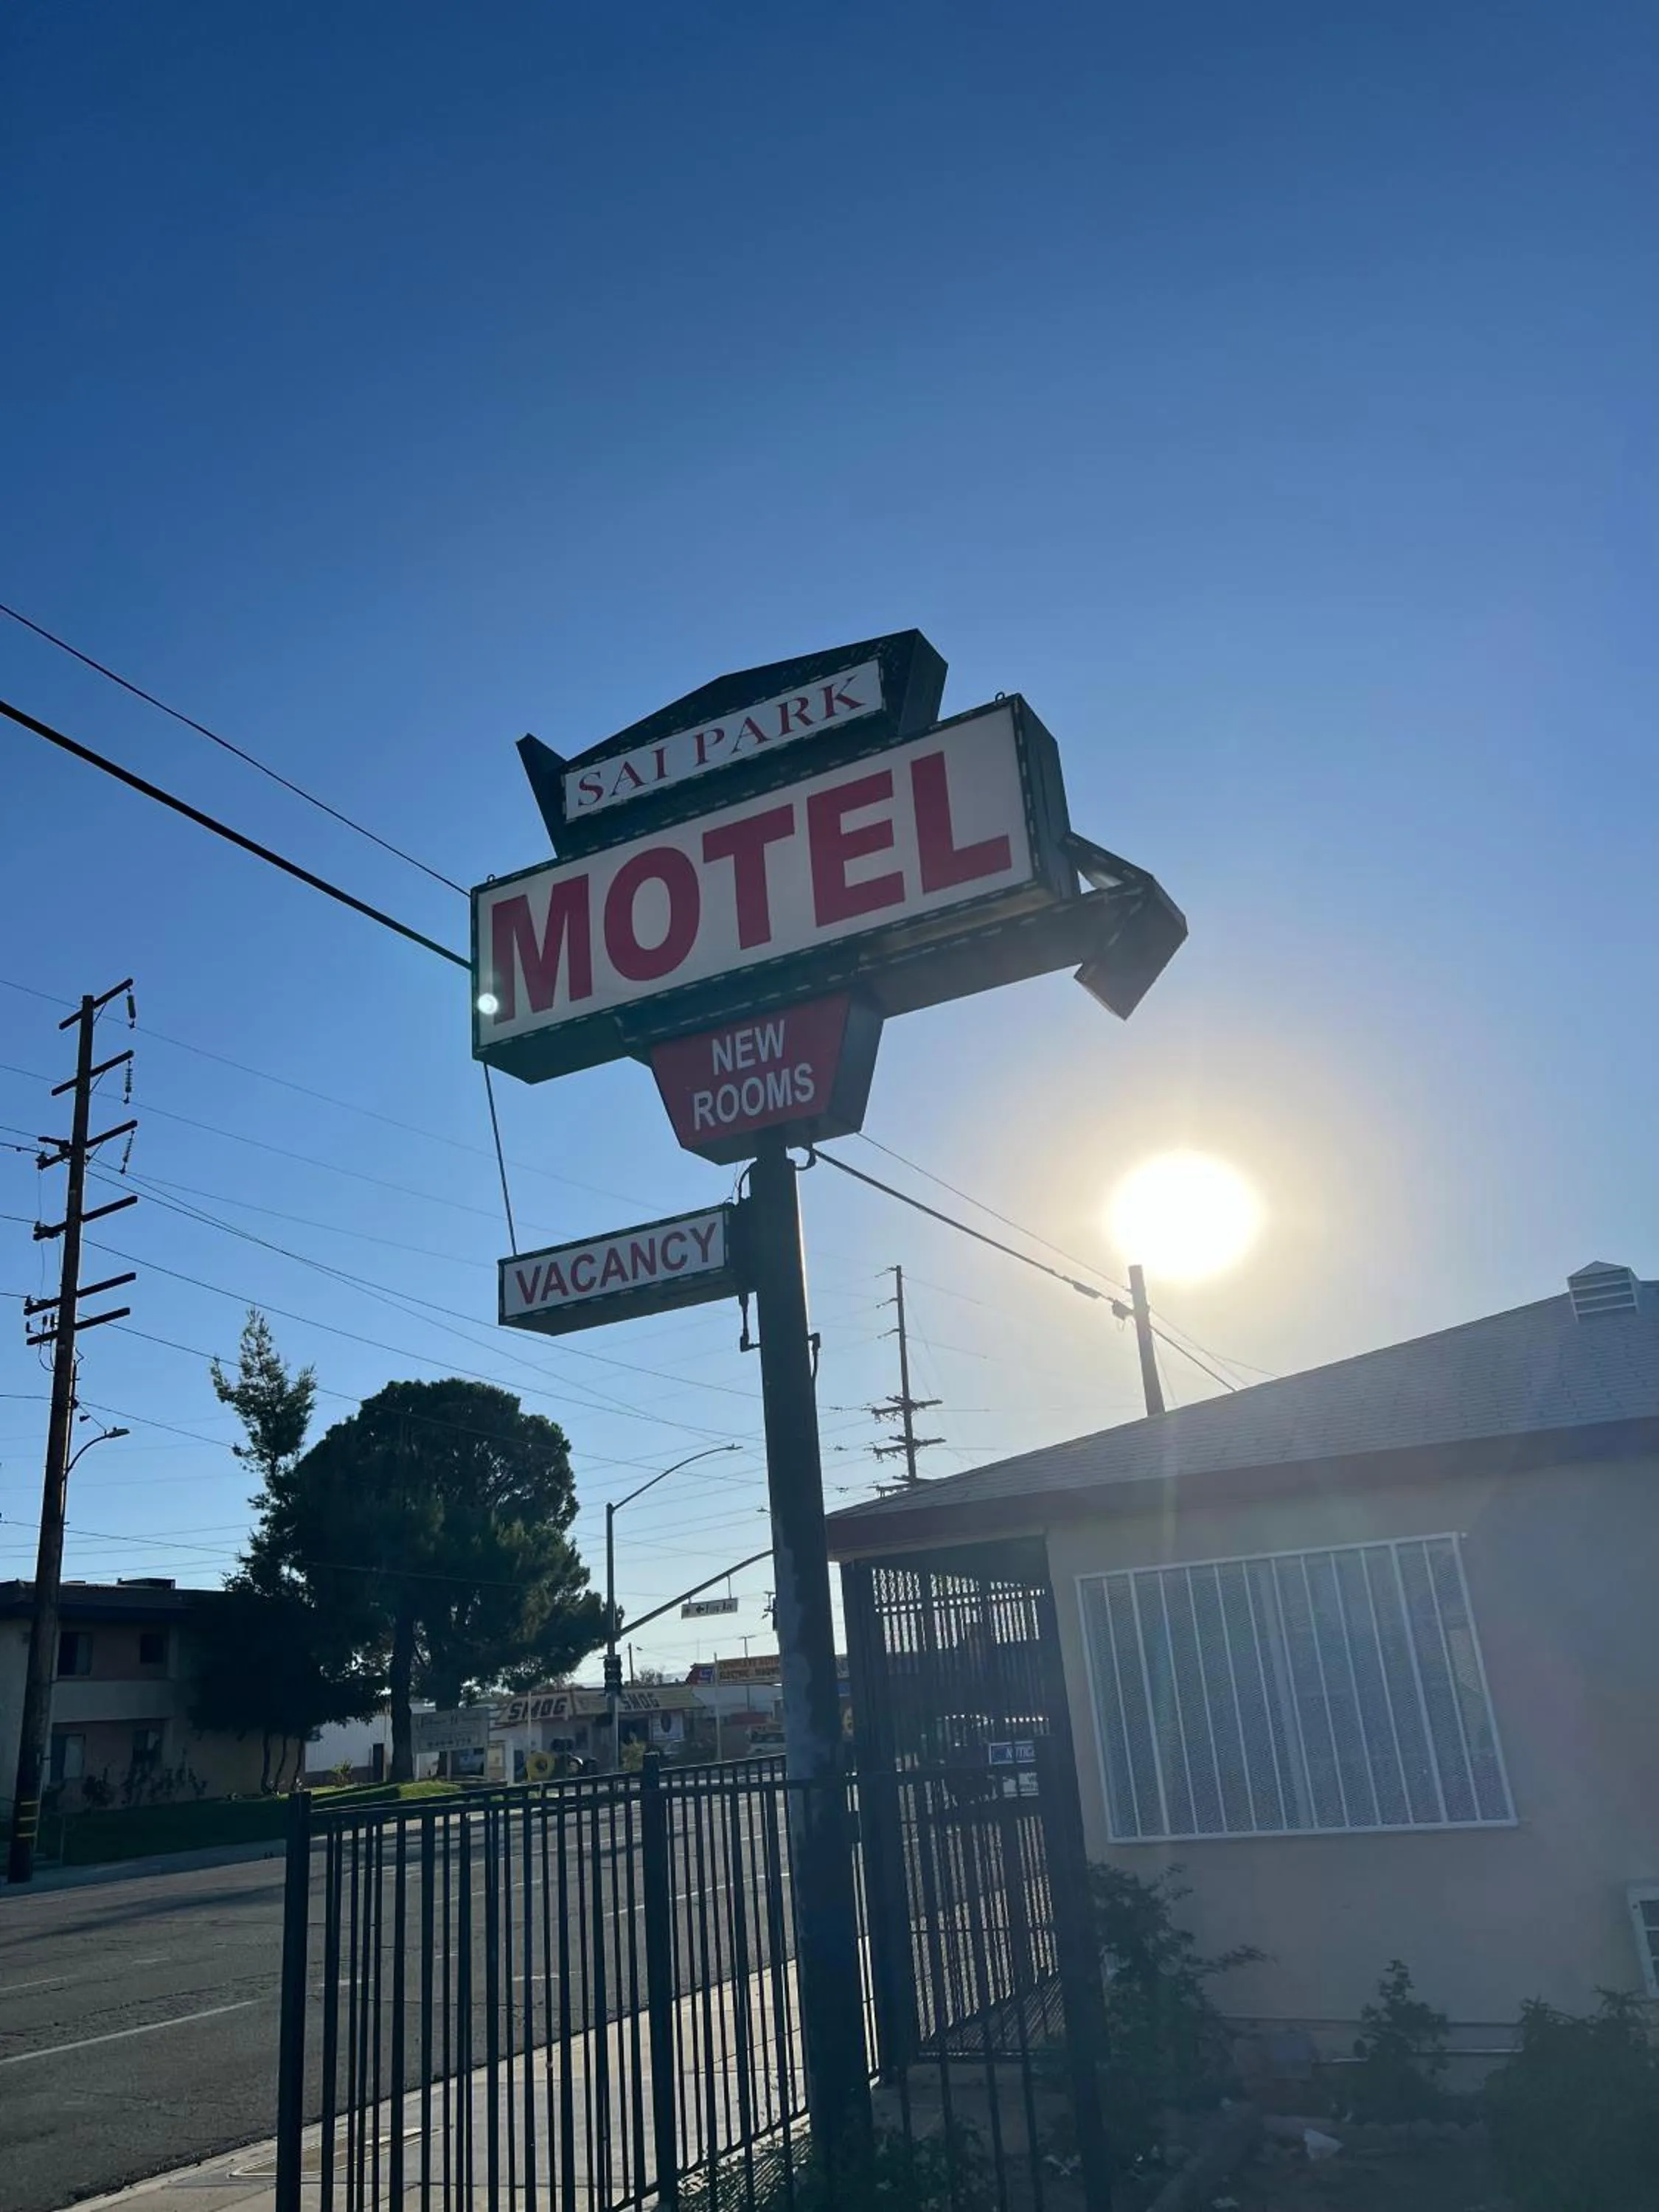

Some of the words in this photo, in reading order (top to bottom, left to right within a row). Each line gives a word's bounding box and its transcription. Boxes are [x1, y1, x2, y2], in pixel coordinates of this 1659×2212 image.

[578, 748, 669, 807] SAI
[693, 675, 867, 768] PARK
[491, 751, 1012, 1026] MOTEL
[712, 1019, 785, 1076] NEW
[693, 1062, 815, 1131] ROOMS
[515, 1222, 717, 1305] VACANCY
[507, 1696, 567, 1720] SMOG
[622, 1692, 661, 1711] SMOG
